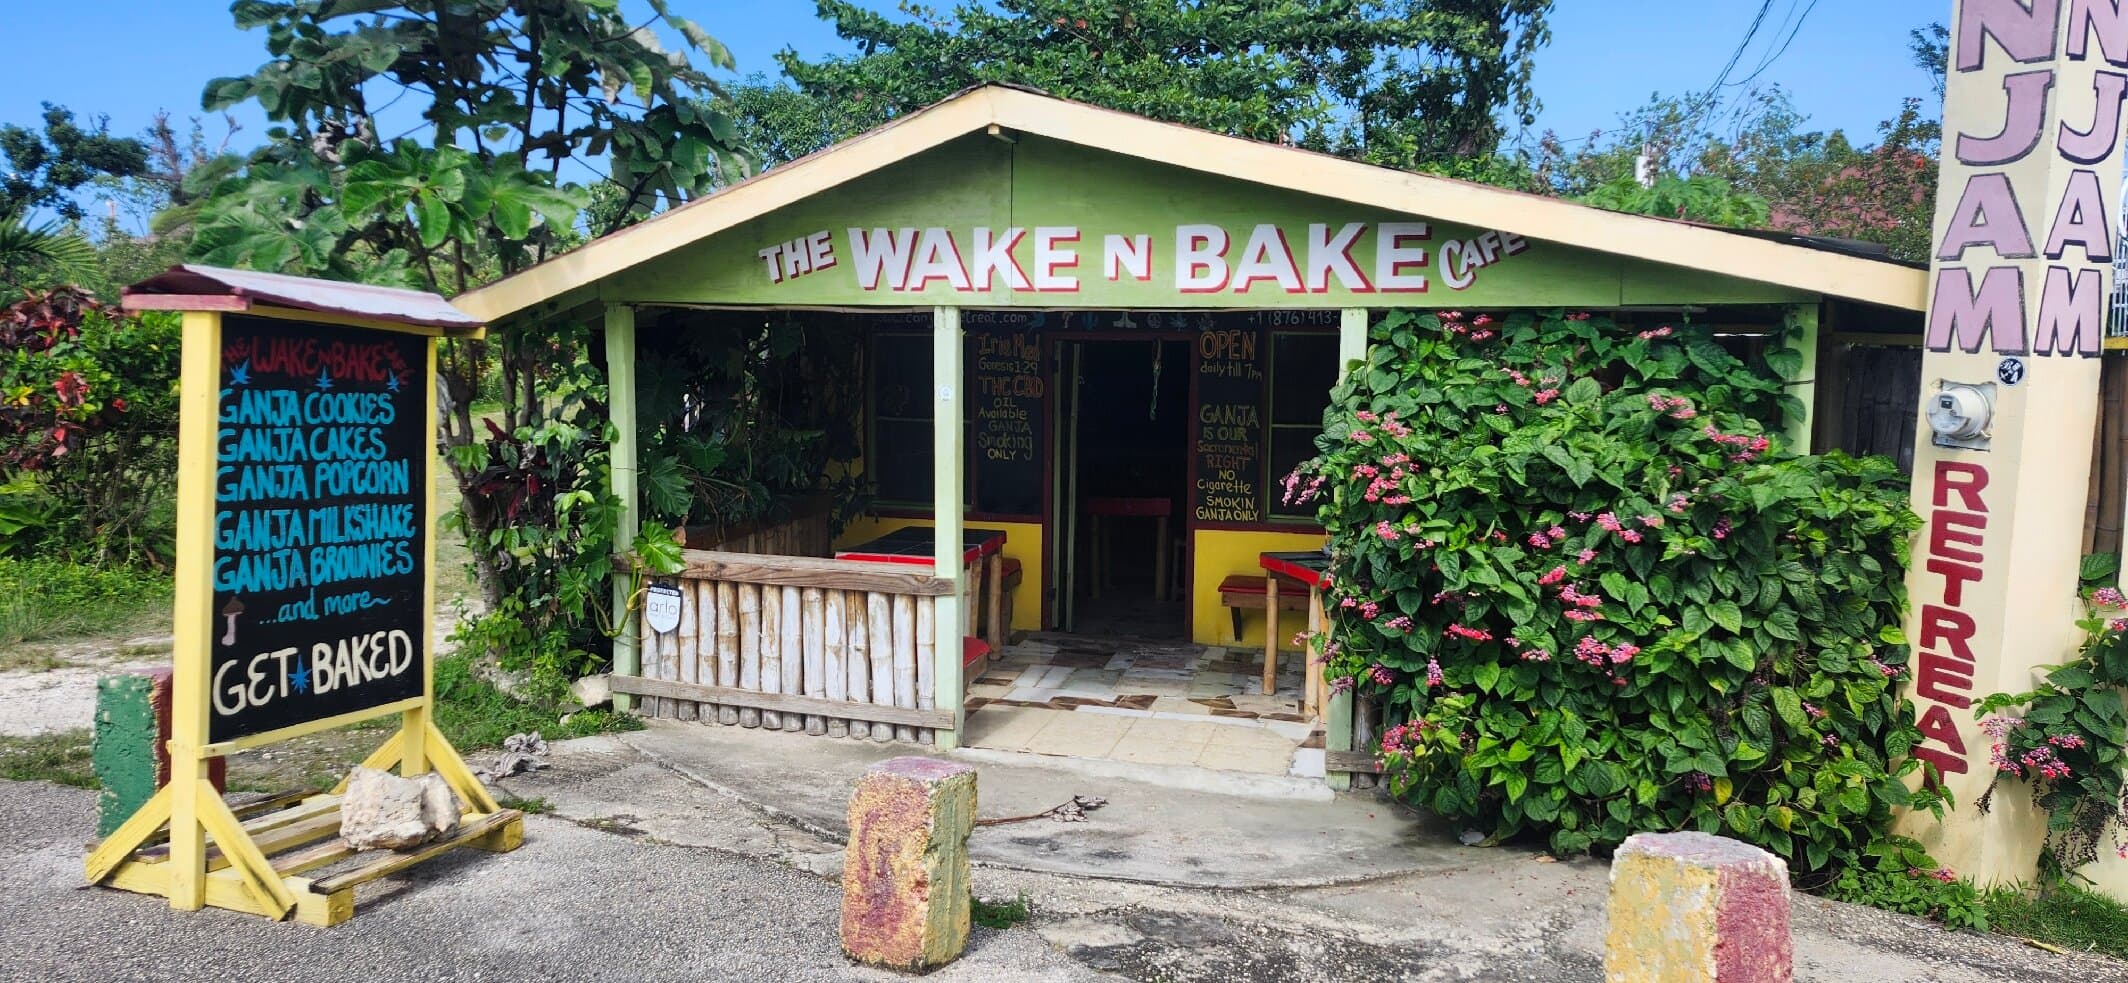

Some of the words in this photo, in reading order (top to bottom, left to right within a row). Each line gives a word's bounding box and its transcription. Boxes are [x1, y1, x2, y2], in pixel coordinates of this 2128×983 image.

[759, 230, 837, 284] THE
[847, 226, 1080, 292] WAKE
[1104, 234, 1152, 281] N
[1175, 221, 1432, 293] BAKE
[1438, 229, 1529, 290] CAFE
[1268, 311, 1304, 326] (876)
[1200, 329, 1256, 360] OPEN
[251, 335, 318, 377] WAKE
[331, 341, 387, 382] BAKE
[1200, 361, 1226, 377] daily
[1227, 361, 1241, 376] till
[218, 387, 302, 426] GANJA
[304, 392, 396, 425] COOKIES
[993, 397, 1016, 408] OIL
[978, 406, 1028, 420] Available
[1200, 403, 1260, 428] GANJA
[988, 420, 1032, 435] GANJA
[1217, 425, 1249, 441] OUR
[216, 428, 308, 463] GANJA
[309, 427, 387, 461] CAKES
[978, 431, 1032, 461] Smoking
[987, 447, 1017, 460] ONLY
[1206, 455, 1250, 471] RIGHT
[215, 465, 310, 502] GANJA
[314, 458, 410, 499] POPCORN
[1218, 469, 1236, 480] NO
[1196, 479, 1253, 495] Cigarette
[1206, 495, 1255, 510] SMOKIN
[1195, 506, 1233, 521] GANJA
[1233, 510, 1259, 522] ONLY
[214, 509, 306, 551] GANJA
[308, 502, 416, 545] MILKSHAKE
[213, 548, 308, 594] GANJA
[310, 540, 414, 586] BROWNIES
[649, 600, 678, 615] arlo
[1911, 460, 1989, 796] RETREAT
[212, 646, 299, 716] GET
[311, 629, 414, 695] BAKED
